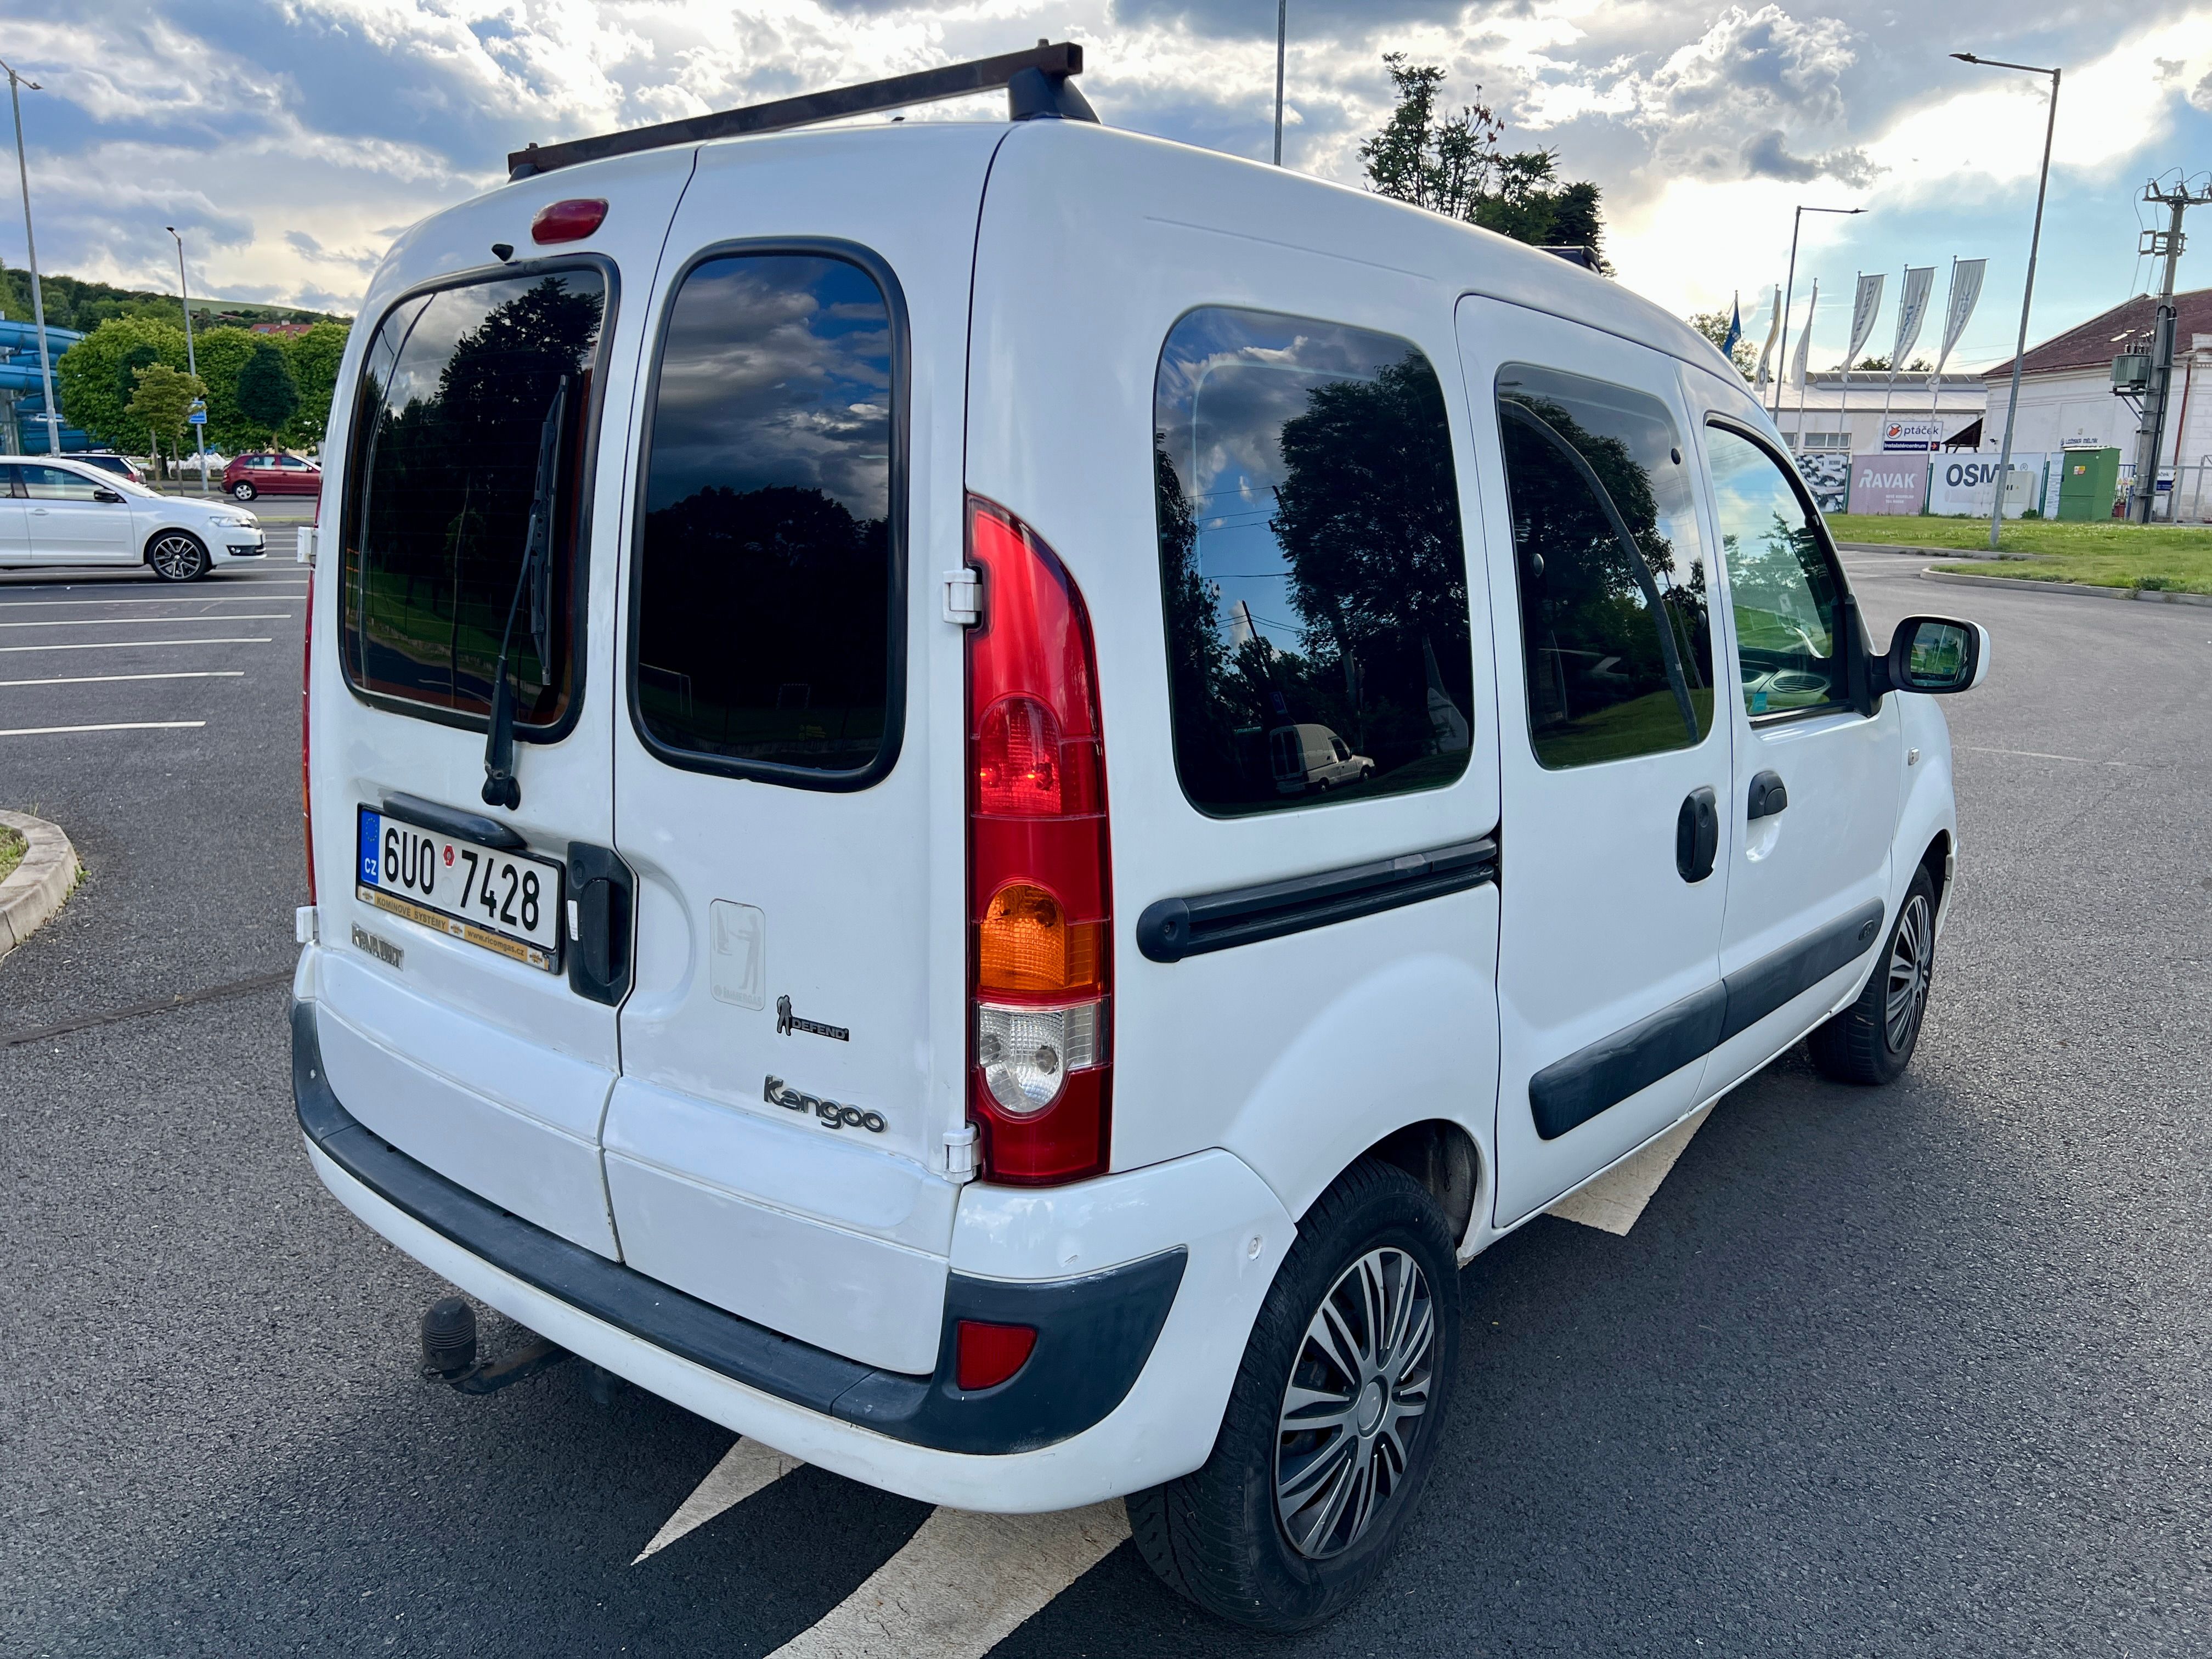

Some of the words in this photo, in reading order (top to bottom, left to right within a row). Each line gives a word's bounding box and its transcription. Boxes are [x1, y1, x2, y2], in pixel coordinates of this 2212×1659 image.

[1859, 469, 1918, 488] RAVAK
[1946, 464, 2015, 487] OSM
[364, 857, 377, 876] CZ
[460, 849, 540, 931] 7428
[376, 896, 411, 917] KOMÍNOVÉ
[414, 911, 446, 929] SYSTÉMY
[467, 930, 524, 956] www.ricomgas.cz
[764, 1074, 888, 1133] Kangoo
